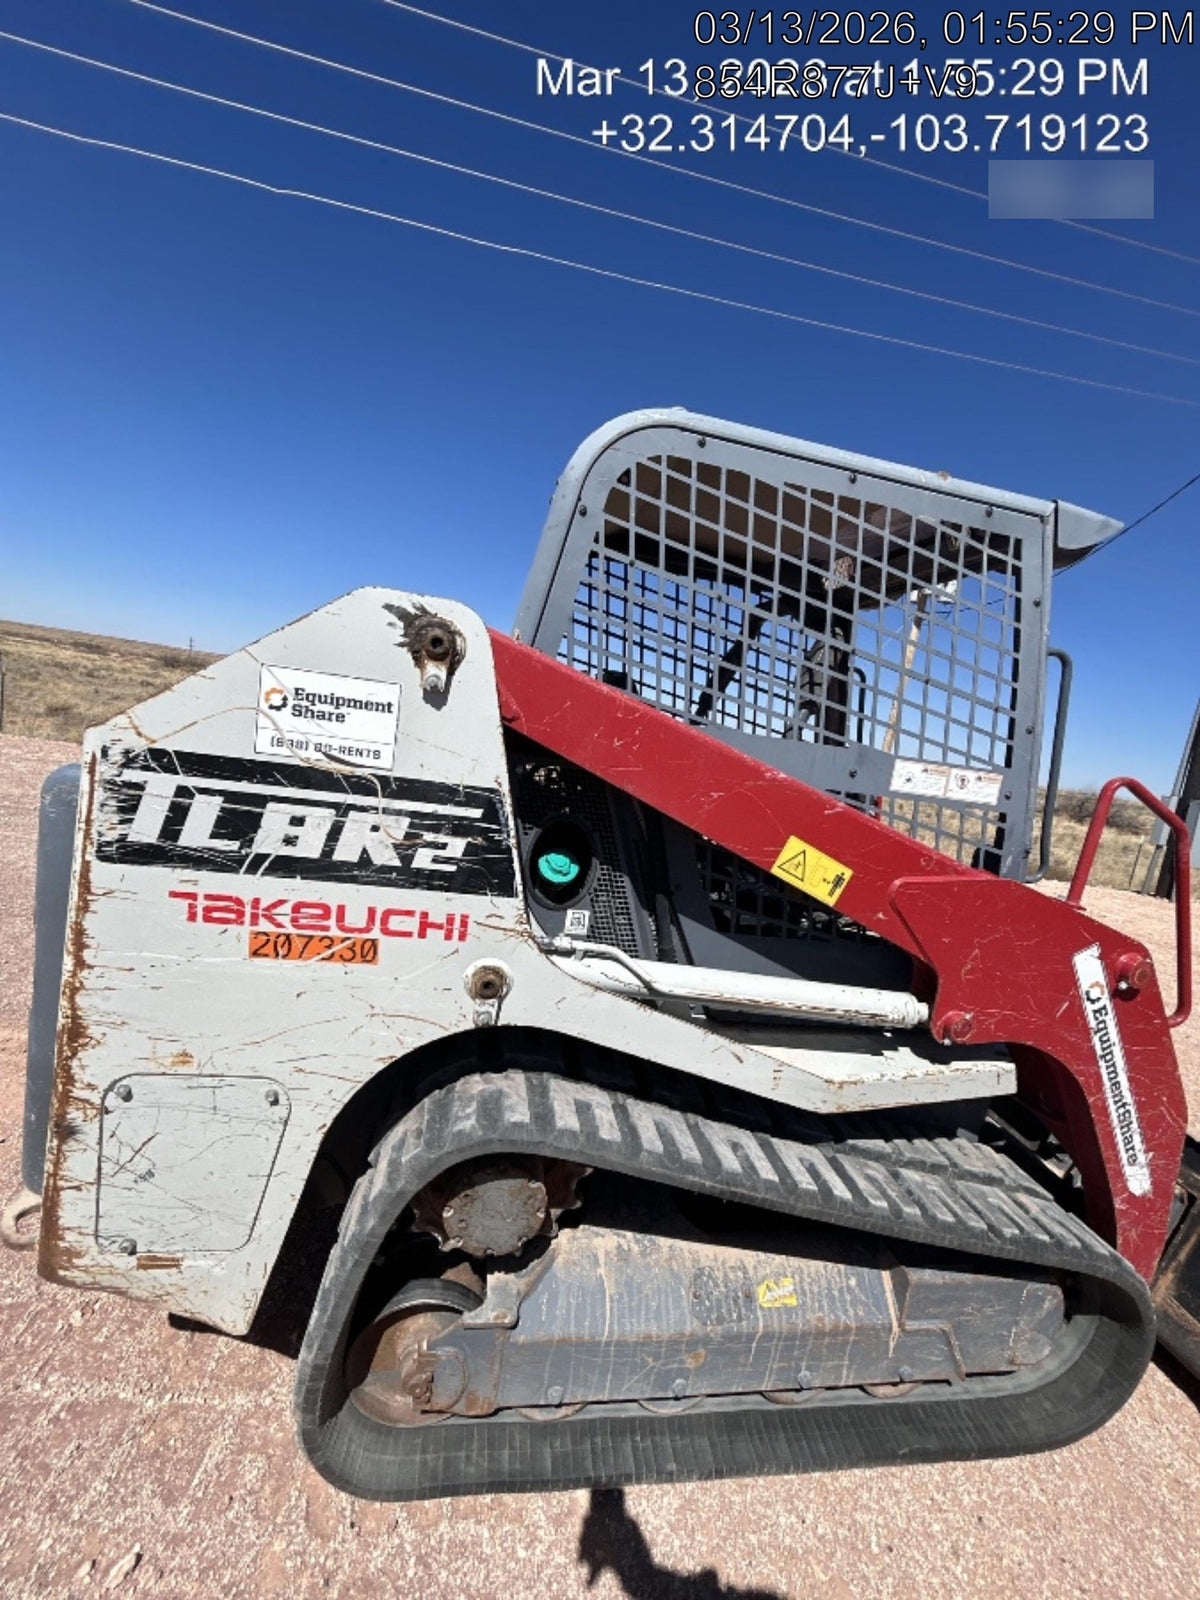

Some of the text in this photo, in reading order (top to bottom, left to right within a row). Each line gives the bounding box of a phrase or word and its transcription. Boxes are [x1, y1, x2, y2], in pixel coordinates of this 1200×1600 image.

[290, 703, 347, 724] Share
[292, 687, 394, 714] Equipment
[250, 931, 379, 963] 207330
[1091, 1001, 1139, 1166] EquipmentShare
